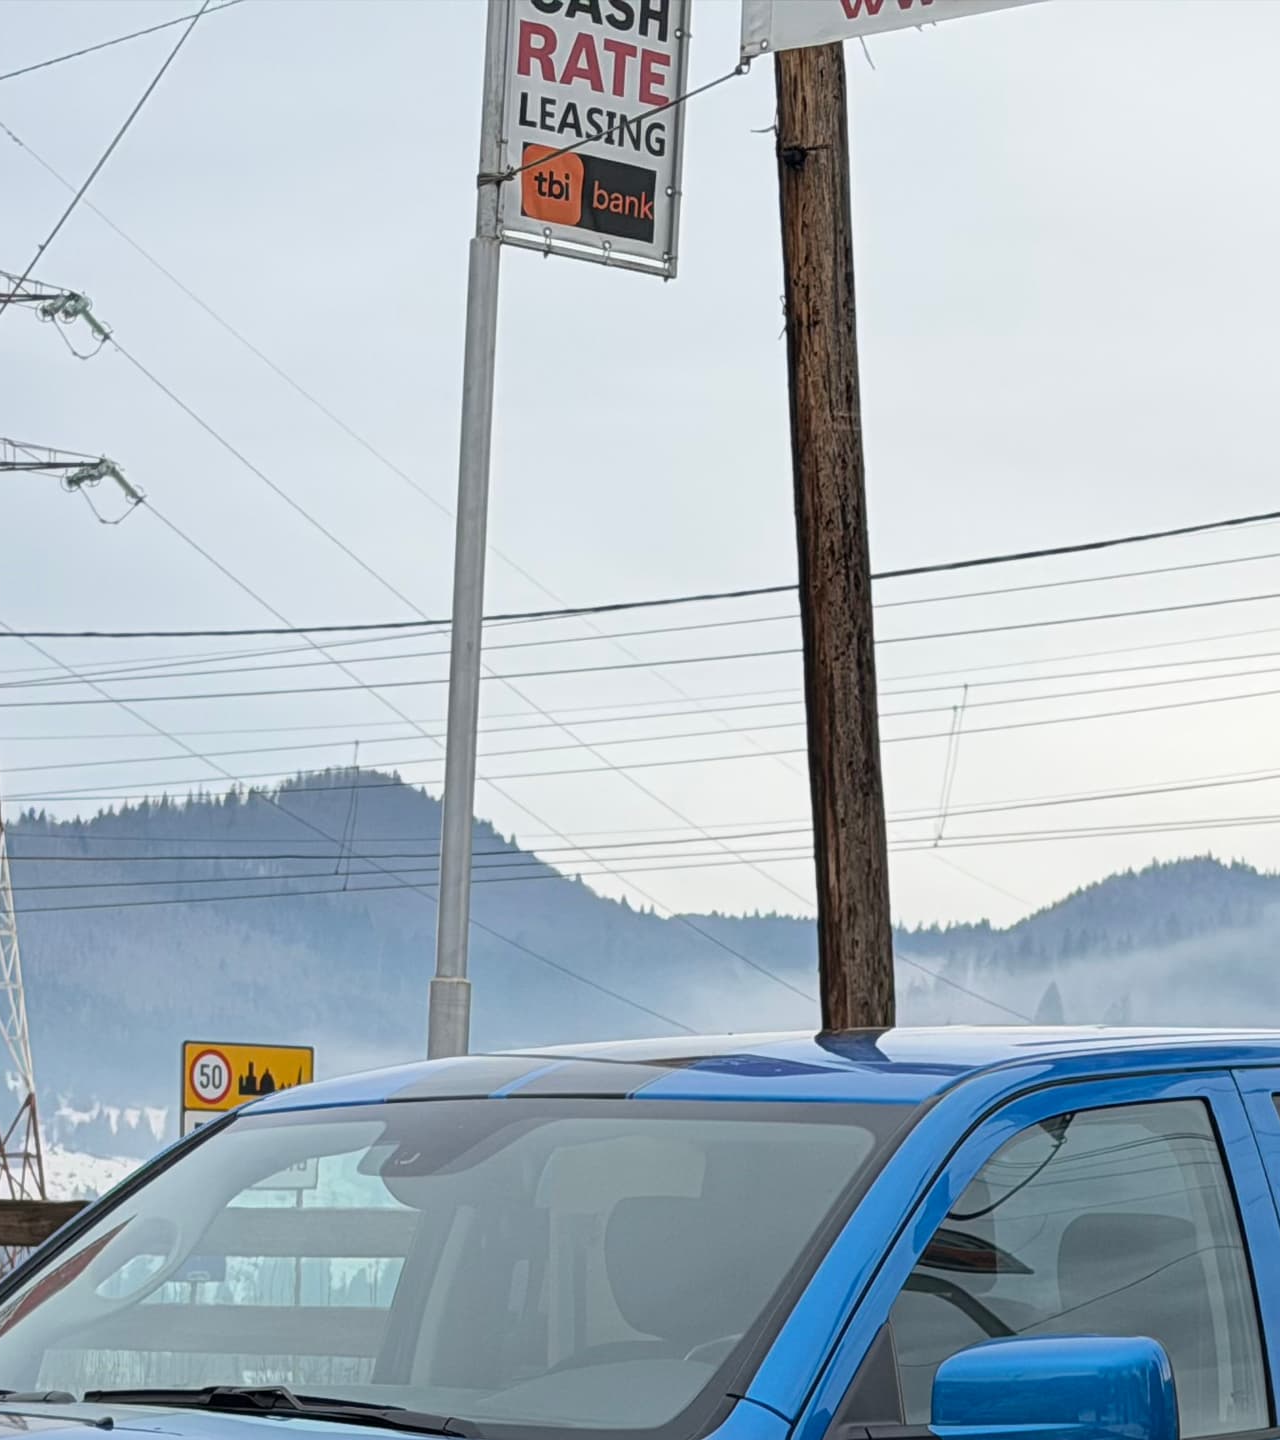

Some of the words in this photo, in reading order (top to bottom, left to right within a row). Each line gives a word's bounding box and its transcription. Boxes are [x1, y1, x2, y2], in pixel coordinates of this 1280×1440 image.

[531, 0, 669, 42] ASH
[517, 19, 671, 107] RATE
[519, 92, 666, 157] LEASING
[534, 170, 570, 201] tbi
[592, 180, 654, 220] bank
[200, 1063, 223, 1090] 50
